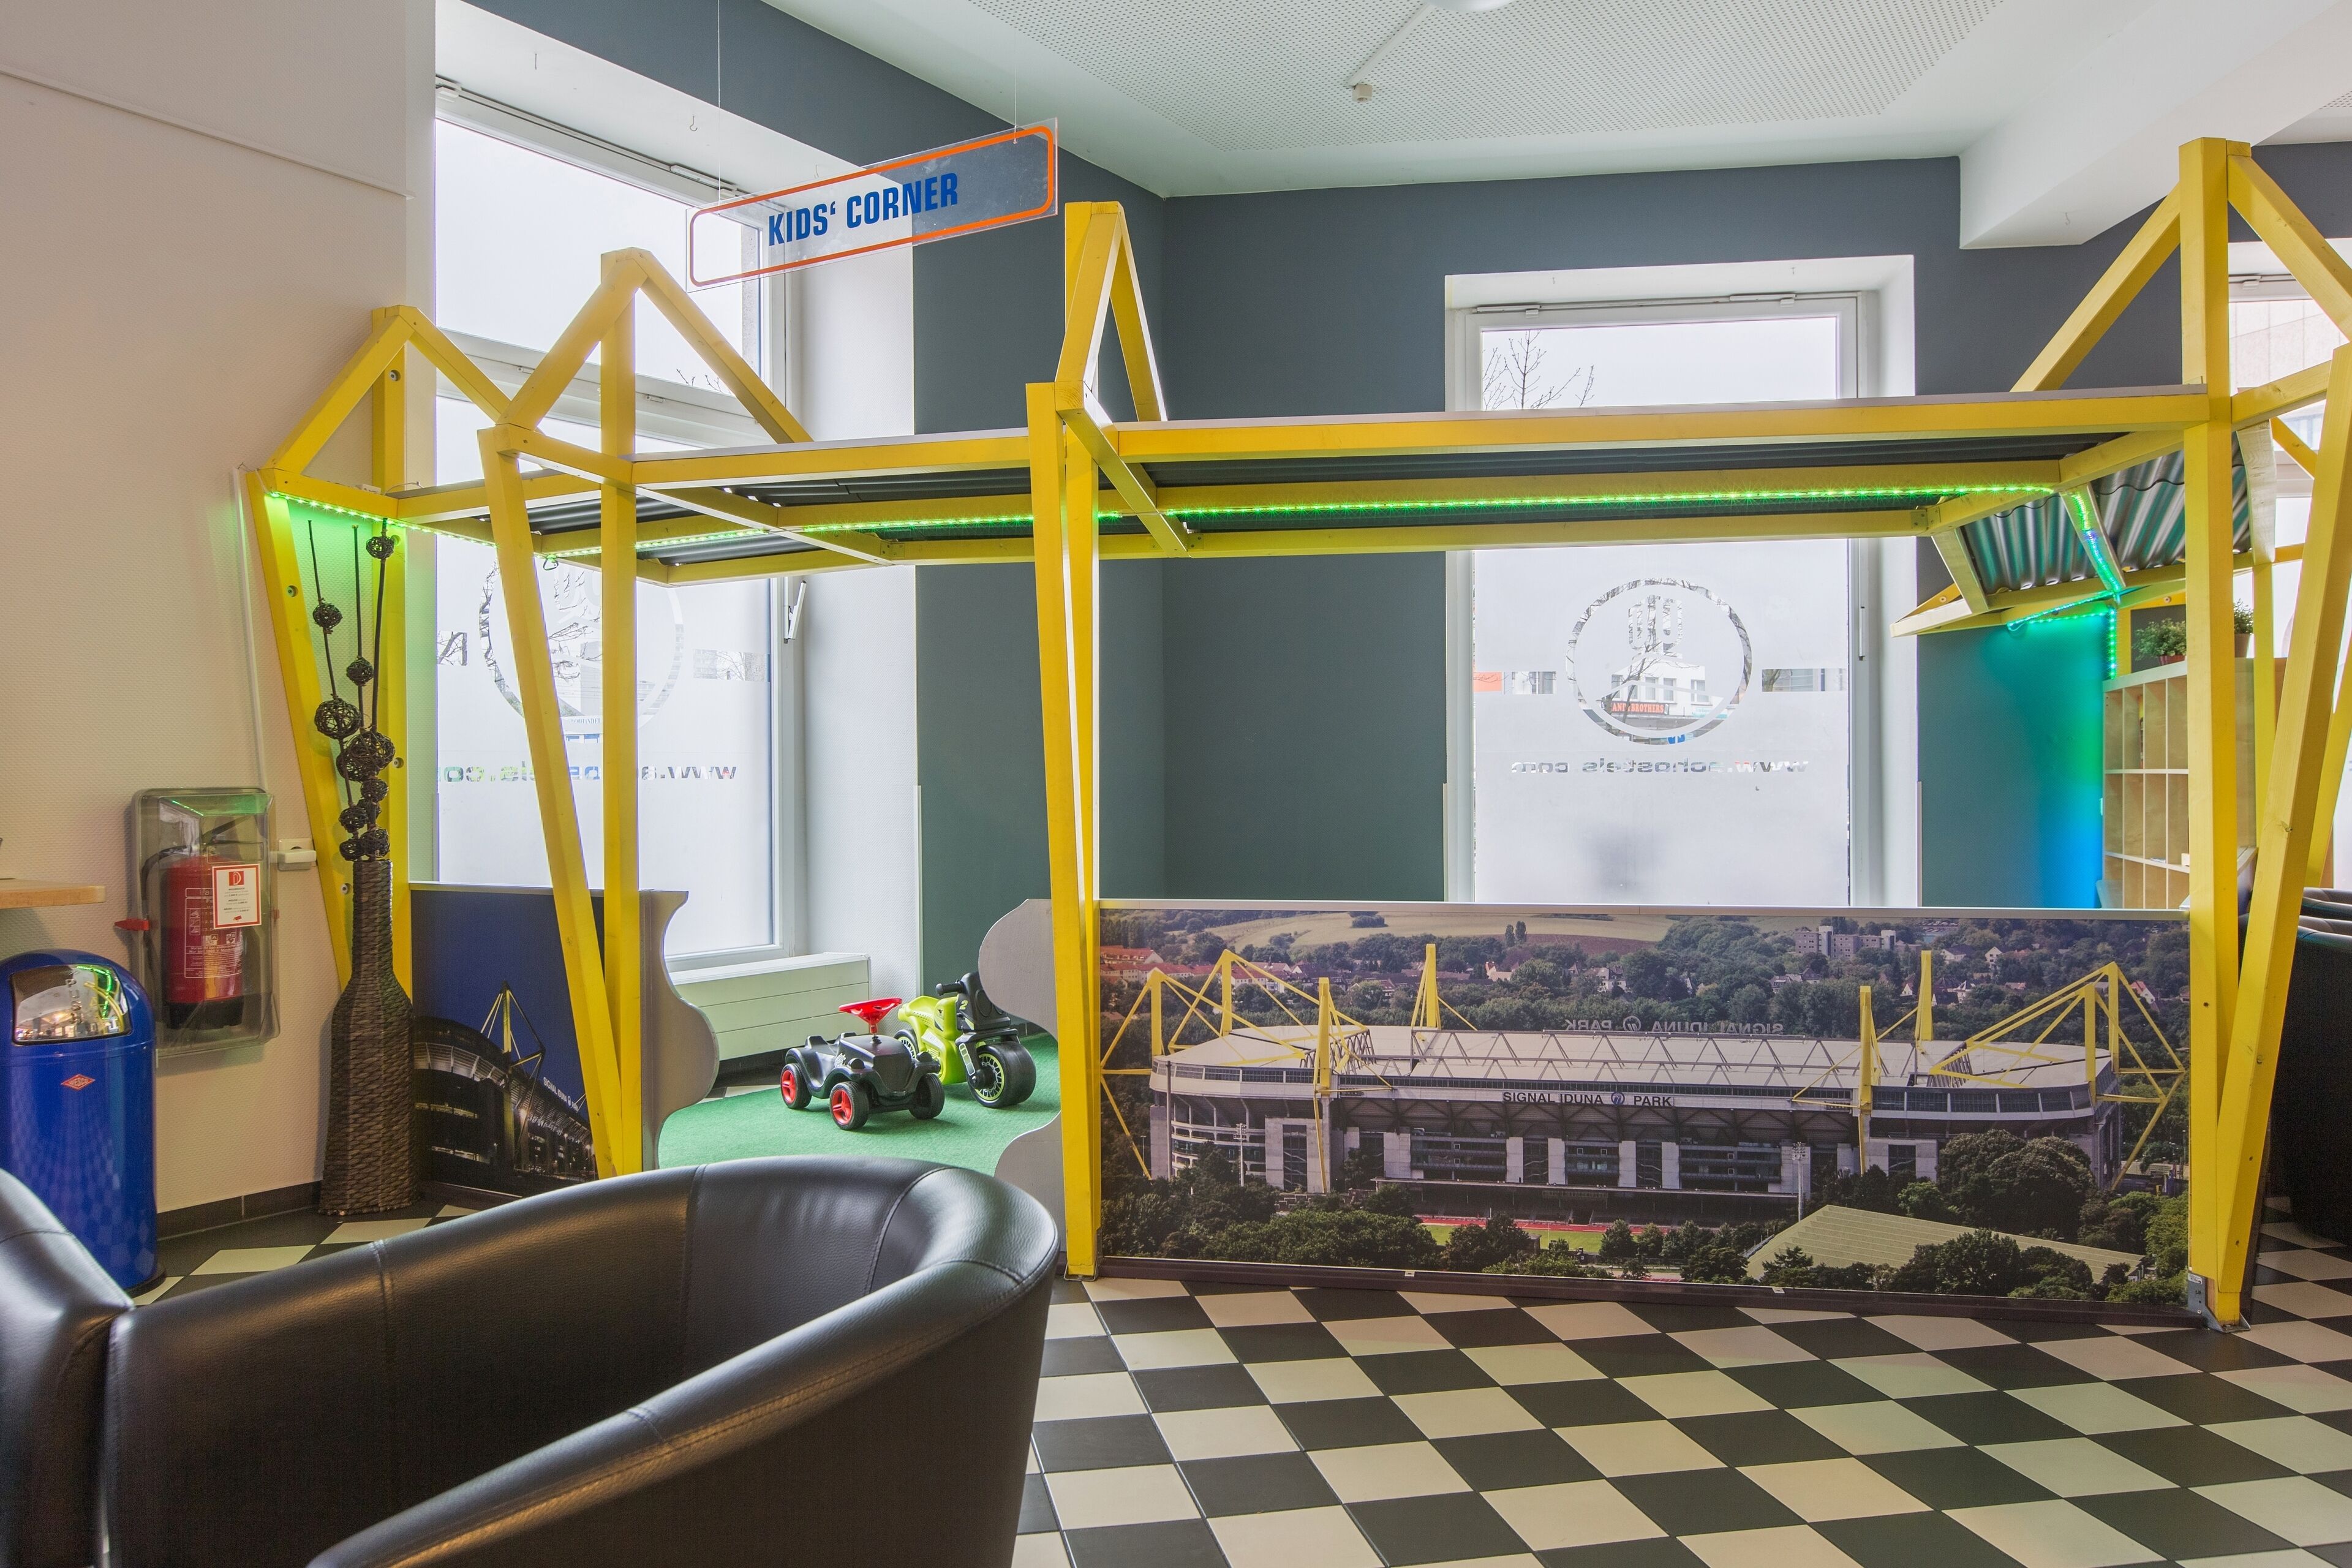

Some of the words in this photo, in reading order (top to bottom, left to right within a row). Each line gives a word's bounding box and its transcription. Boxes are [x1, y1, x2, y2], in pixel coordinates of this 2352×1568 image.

[846, 172, 958, 228] CORNER
[1630, 704, 1664, 713] BROTHERS
[959, 1000, 968, 1010] 2
[1503, 1091, 1555, 1103] SIGNAL
[1560, 1093, 1603, 1104] IDUNA
[1634, 1095, 1672, 1107] PARK
